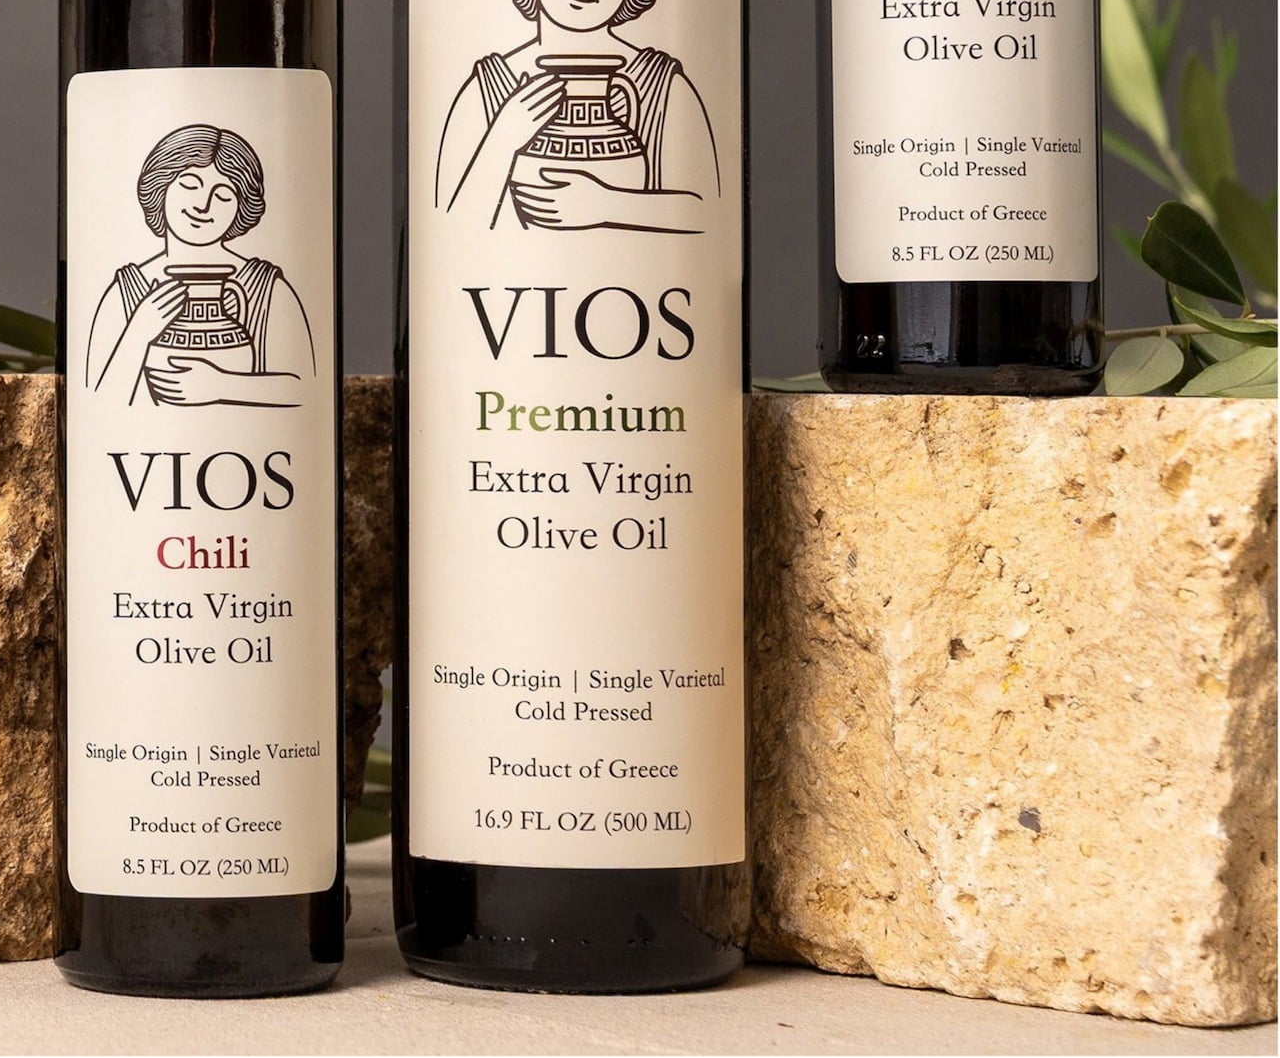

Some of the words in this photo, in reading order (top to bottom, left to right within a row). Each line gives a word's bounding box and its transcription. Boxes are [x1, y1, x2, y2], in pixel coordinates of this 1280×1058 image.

[904, 35, 982, 61] Olive
[994, 34, 1037, 59] Oil
[854, 139, 895, 157] Single
[901, 138, 955, 155] Origin
[977, 137, 1026, 155] Single
[1031, 137, 1081, 153] Varietal
[920, 161, 959, 177] Cold
[966, 161, 1026, 176] Pressed
[899, 206, 964, 221] Product
[970, 205, 989, 220] of
[993, 205, 1046, 220] Greece
[892, 247, 914, 261] 8.5
[920, 246, 944, 260] FL
[949, 246, 979, 260] OZ
[985, 245, 1019, 263] (250
[1024, 245, 1054, 264] ML)
[462, 287, 694, 360] VIOS
[475, 391, 686, 432] Premium
[107, 451, 294, 512] VIOS
[469, 461, 570, 493] Extra
[582, 462, 692, 500] Virgin
[497, 516, 598, 549] Olive
[612, 517, 668, 550] Oil
[157, 535, 250, 569] Chili
[113, 593, 193, 619] Extra
[203, 593, 293, 623] Virgin
[136, 638, 216, 664] Olive
[228, 636, 273, 663] Oil
[434, 665, 485, 689] Single
[492, 668, 561, 692] Origin
[590, 670, 653, 693] Single
[659, 667, 725, 688] Varietal
[515, 701, 565, 720] Cold
[574, 702, 652, 721] Pressed
[86, 743, 127, 762] Single
[132, 745, 187, 764] Origin
[210, 744, 260, 763] Single
[266, 741, 320, 759] Varietal
[151, 771, 191, 787] Cold
[197, 770, 260, 786] Pressed
[489, 756, 572, 778] Product
[579, 759, 604, 778] of
[609, 759, 678, 778] Greece
[130, 817, 196, 833] Product
[202, 817, 222, 833] of
[226, 817, 281, 833] Greece
[475, 809, 512, 829] 16.9
[521, 811, 551, 830] FL
[558, 812, 596, 831] OZ
[605, 812, 647, 836] (500
[654, 810, 691, 834] ML)
[123, 858, 145, 874] 8.5
[151, 859, 175, 875] FL
[180, 860, 211, 875] OZ
[217, 859, 252, 879] (250
[257, 857, 289, 876] ML)
